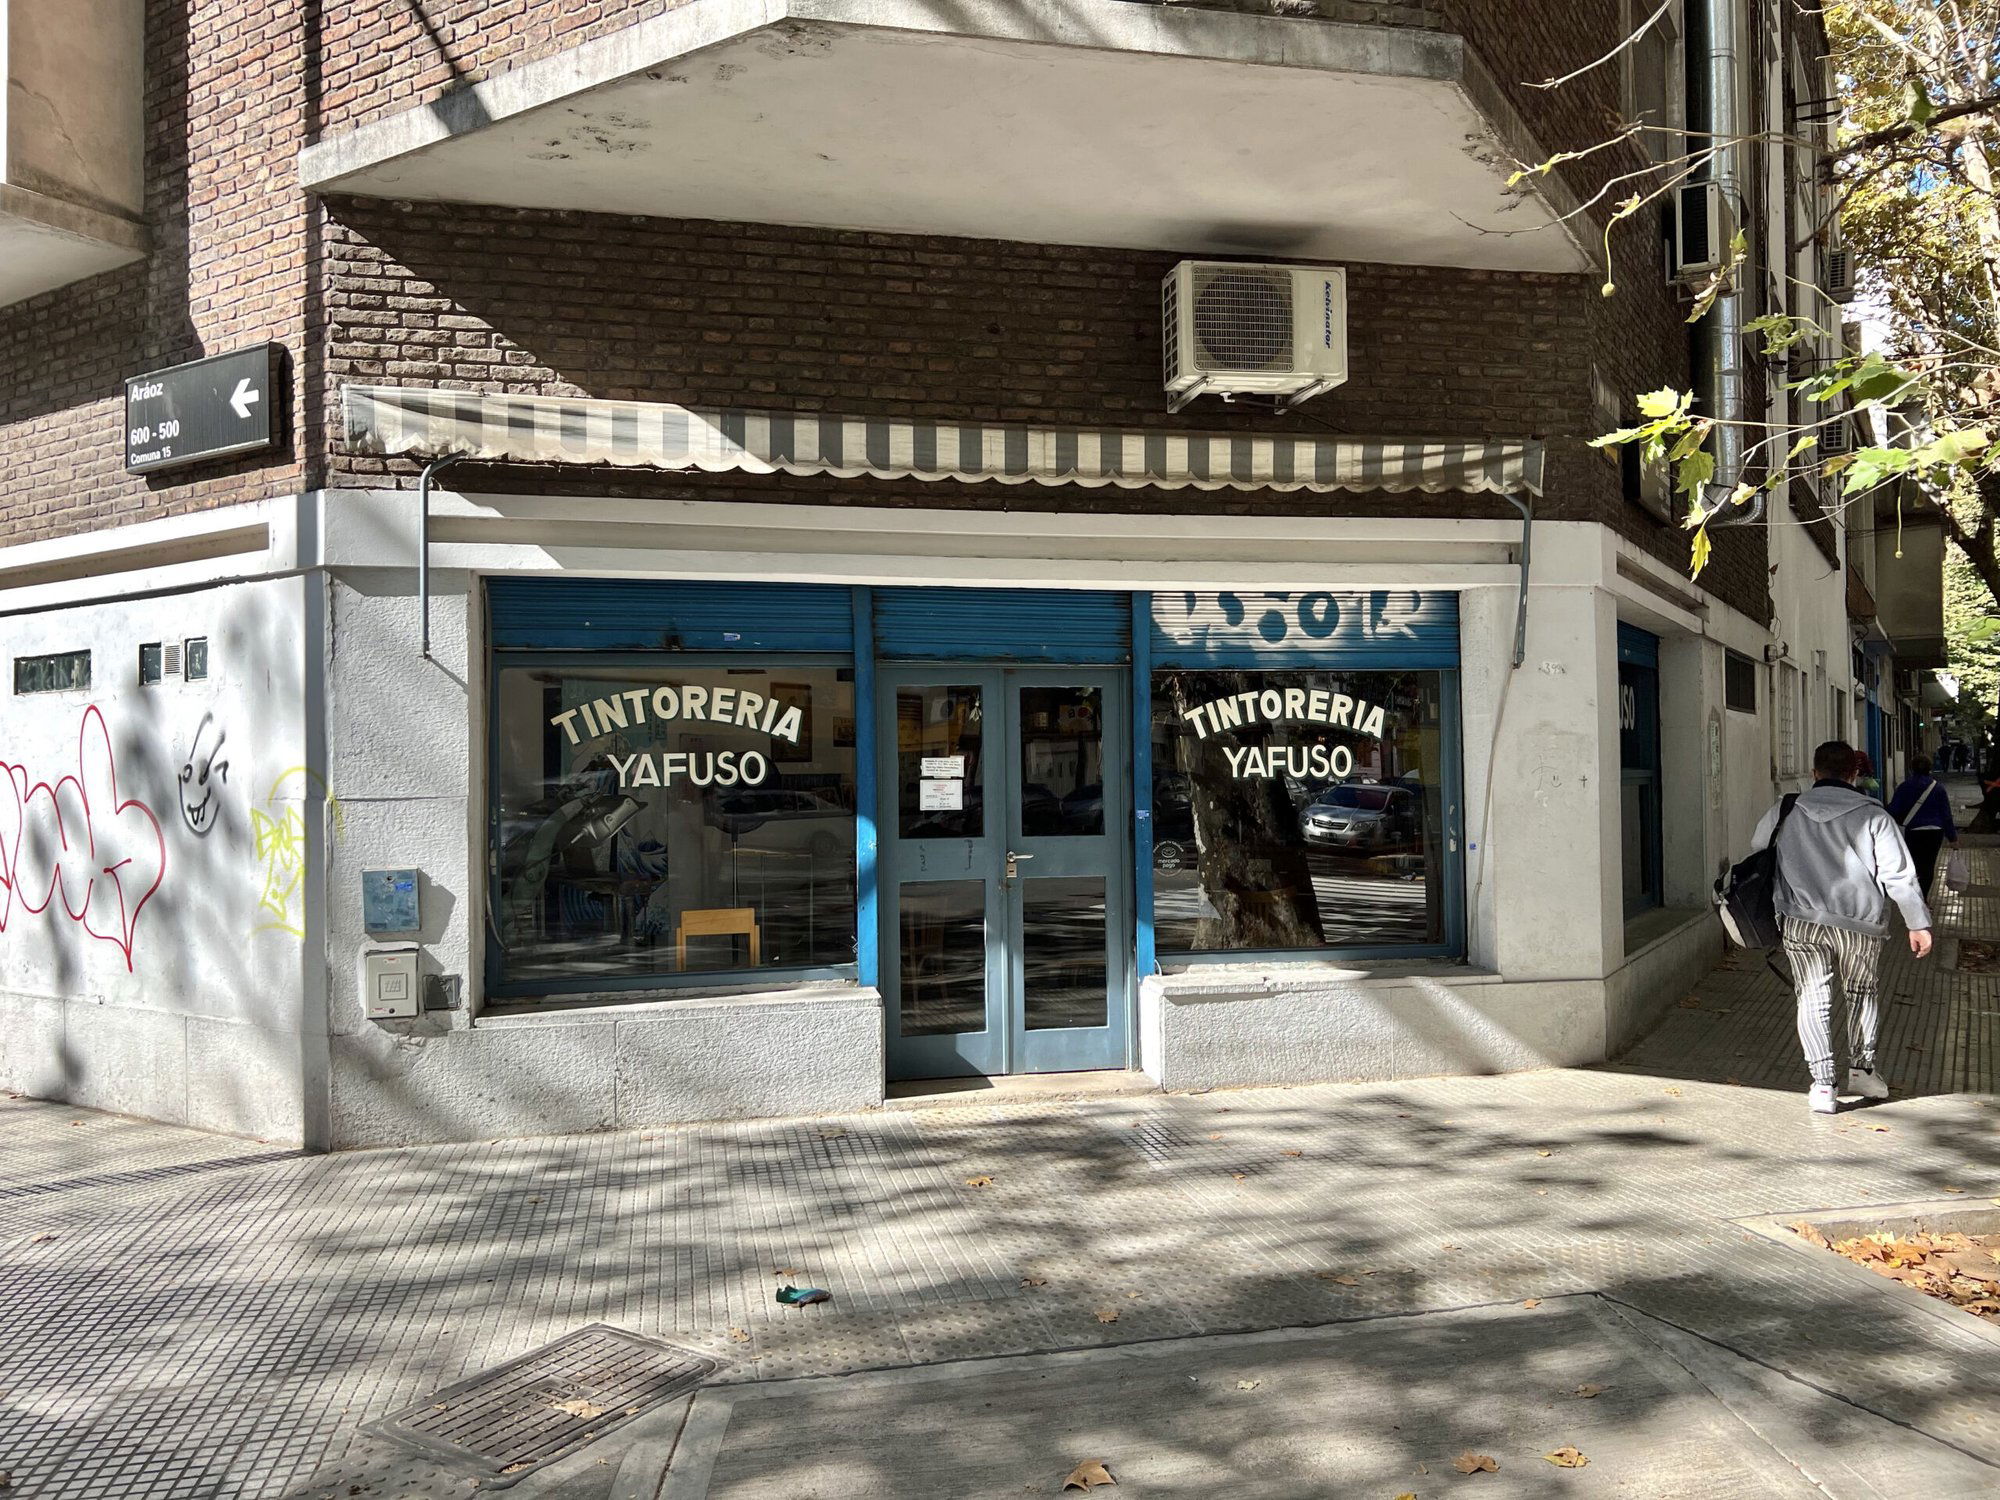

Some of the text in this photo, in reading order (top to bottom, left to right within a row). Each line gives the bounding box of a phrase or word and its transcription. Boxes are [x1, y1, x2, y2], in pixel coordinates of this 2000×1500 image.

[1325, 281, 1333, 349] Kelvinator
[131, 382, 163, 402] Aráoz
[131, 426, 150, 445] 600
[159, 420, 180, 439] 500
[131, 446, 171, 465] Comuna 15
[550, 685, 802, 745] TINTORERIA
[1183, 688, 1385, 740] TINTORERIA
[607, 751, 766, 788] YAFUSO
[1222, 744, 1353, 778] YAFUSO
